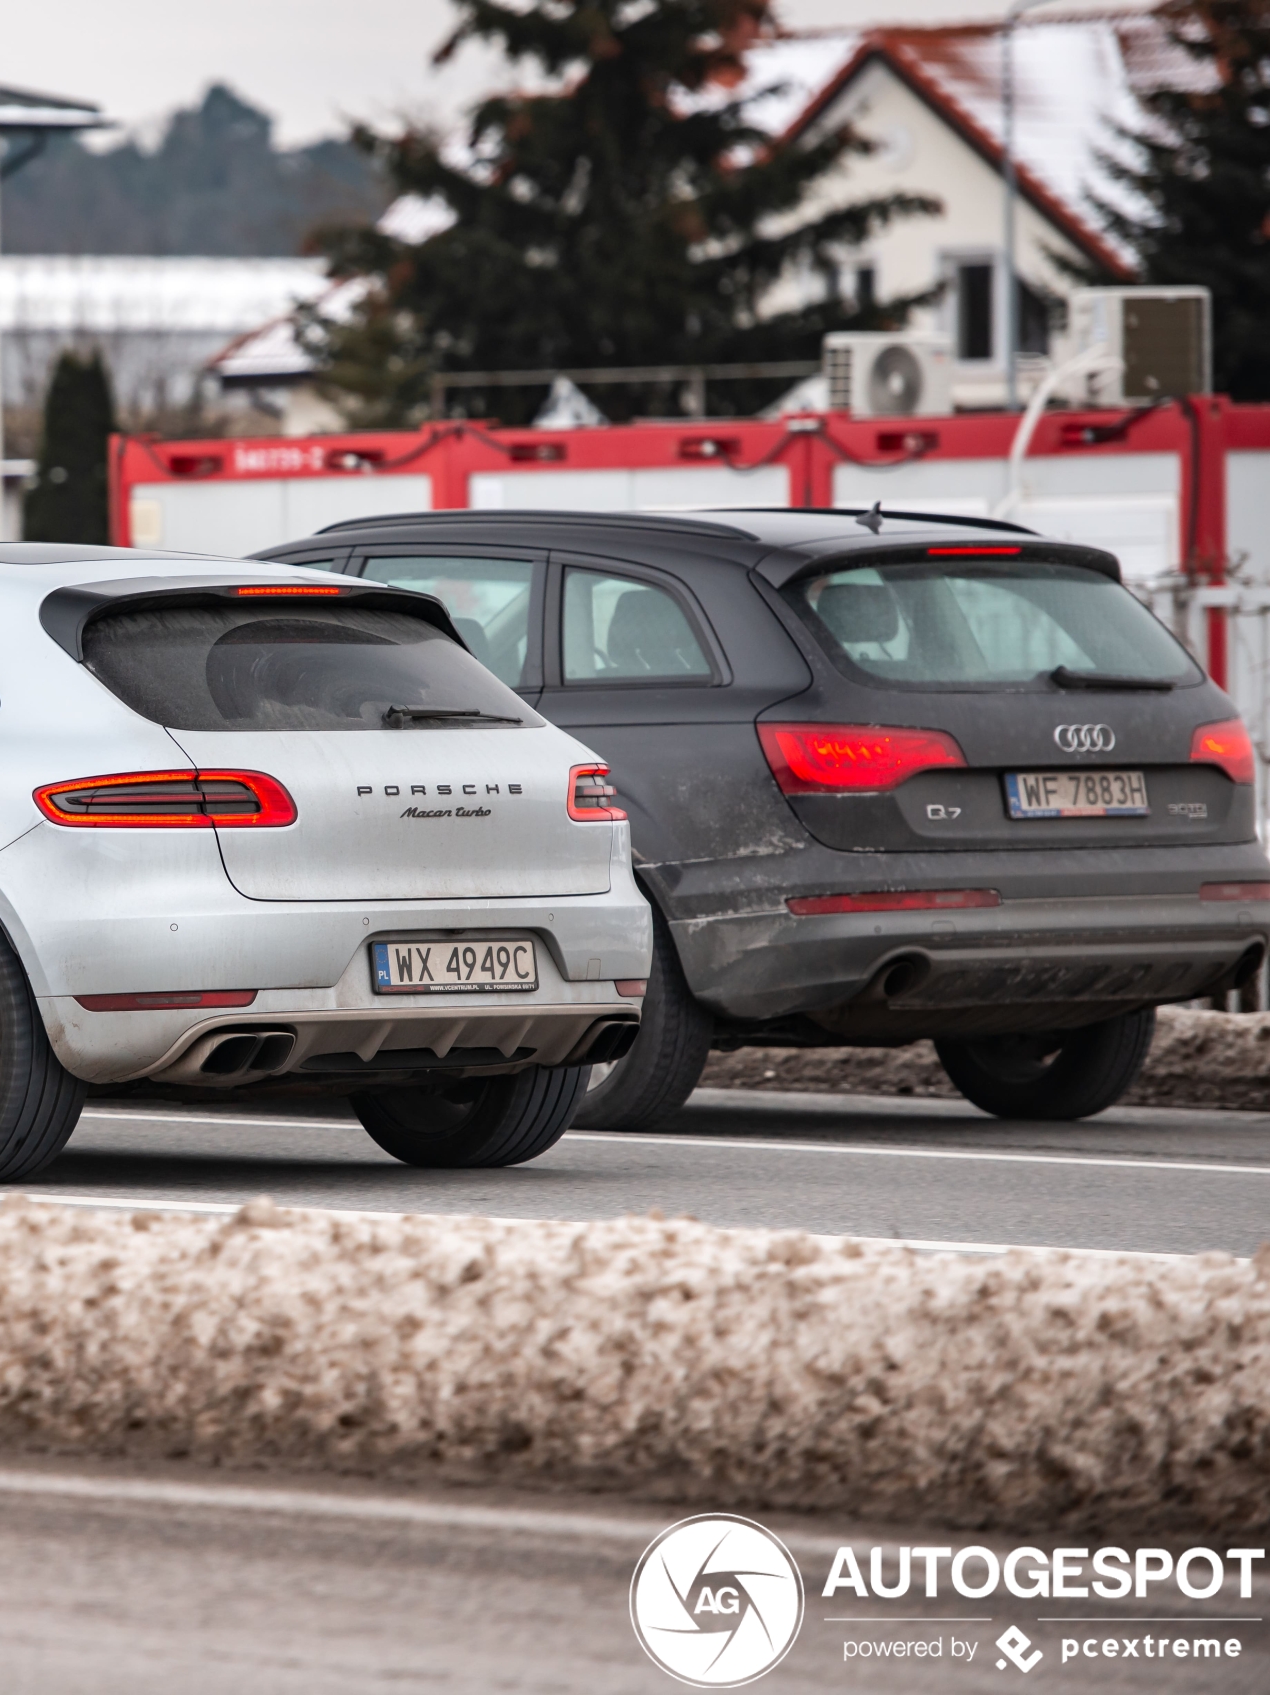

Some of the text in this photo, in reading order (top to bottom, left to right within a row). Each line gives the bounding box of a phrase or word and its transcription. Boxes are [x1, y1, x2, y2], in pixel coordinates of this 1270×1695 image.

[357, 784, 523, 796] PORSCHE
[1023, 775, 1146, 808] WF 7883H
[400, 806, 452, 818] Macan
[927, 804, 962, 820] Q7
[395, 945, 530, 983] WX 4949C
[378, 970, 389, 980] PL
